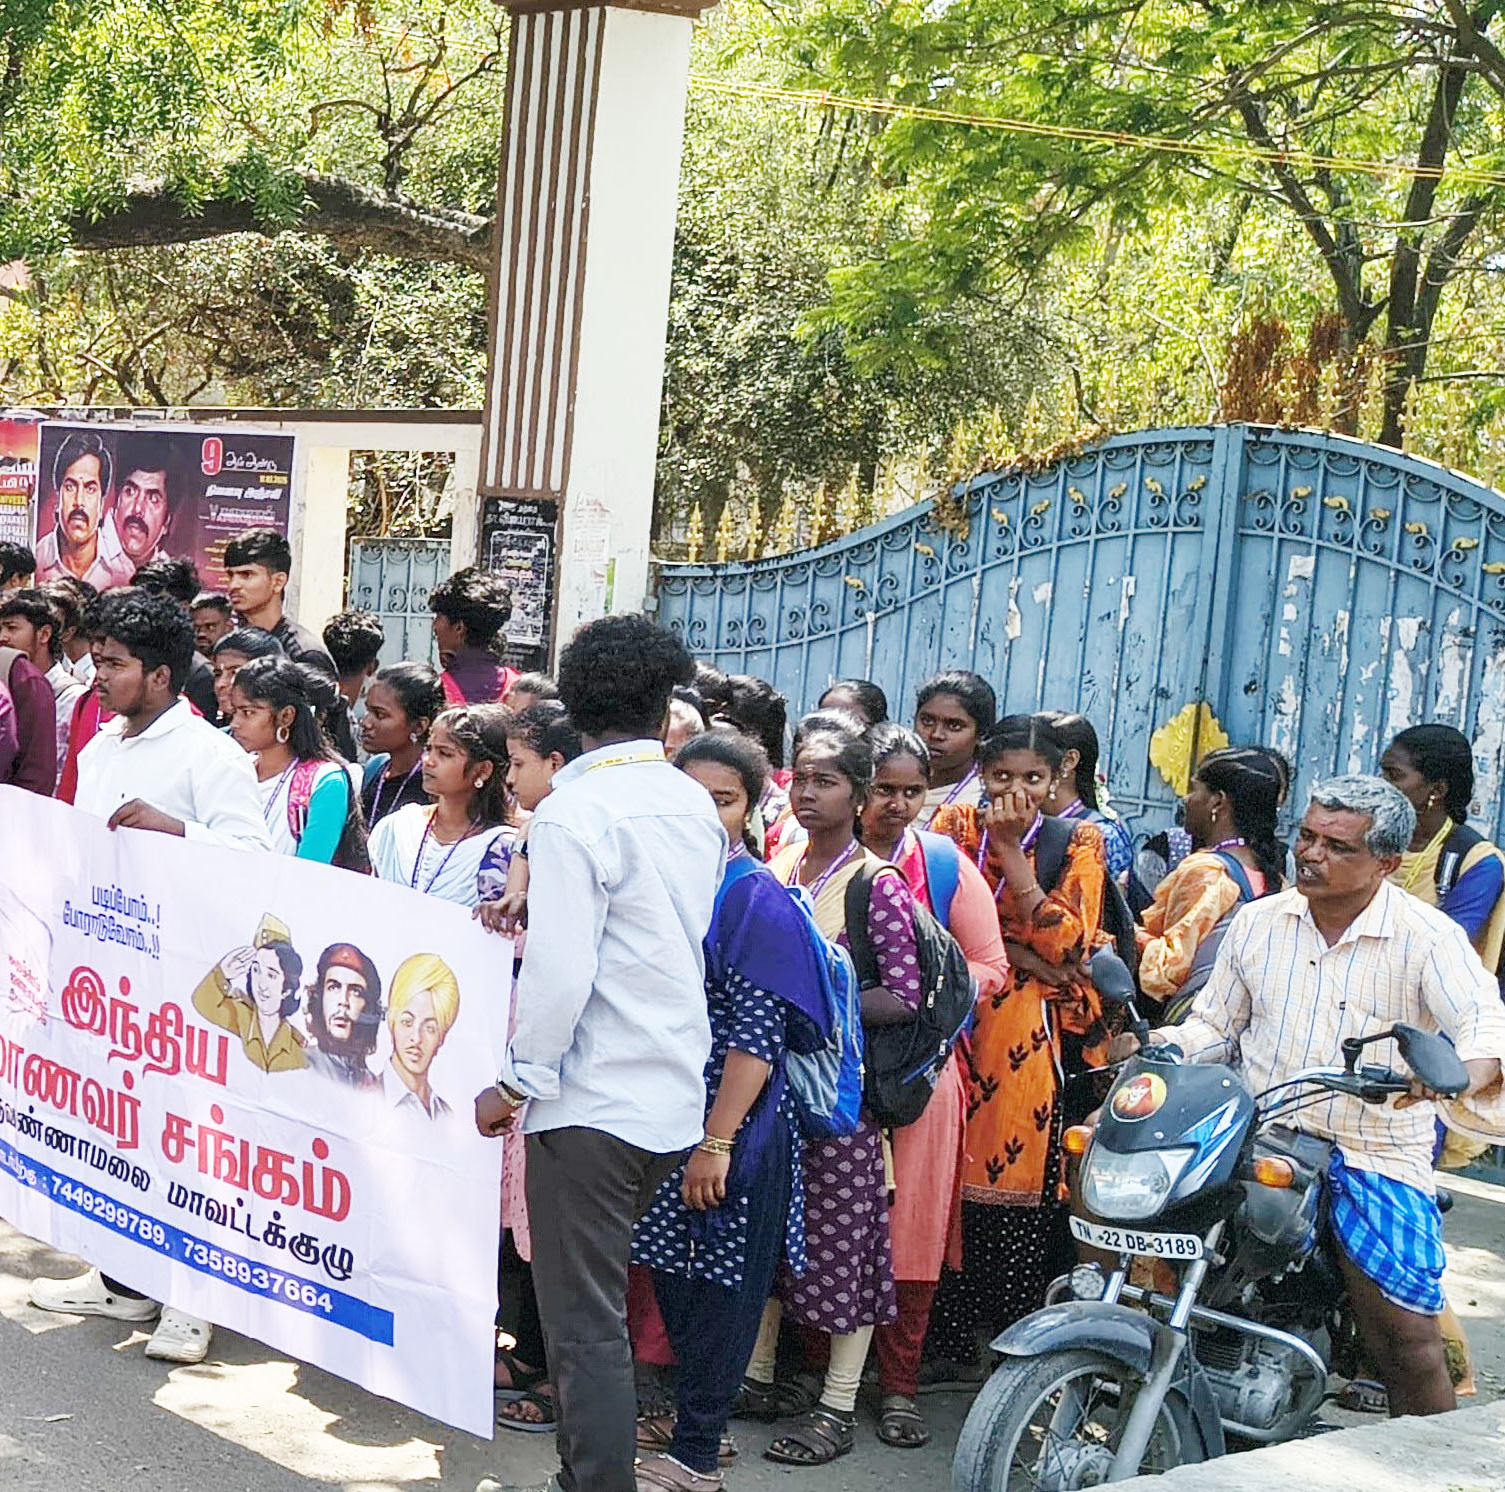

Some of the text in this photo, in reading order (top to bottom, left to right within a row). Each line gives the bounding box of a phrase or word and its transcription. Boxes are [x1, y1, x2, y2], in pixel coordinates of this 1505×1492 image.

[201, 437, 223, 475] 9
[61, 966, 229, 1086] இந்திய
[161, 1103, 352, 1222] சங்கம்
[167, 1182, 354, 1281] மாவட்டக்குழு
[182, 1237, 333, 1313] 7358937664
[1076, 1221, 1092, 1241] TN
[1125, 1233, 1147, 1252] DB
[1153, 1237, 1197, 1255] 3189
